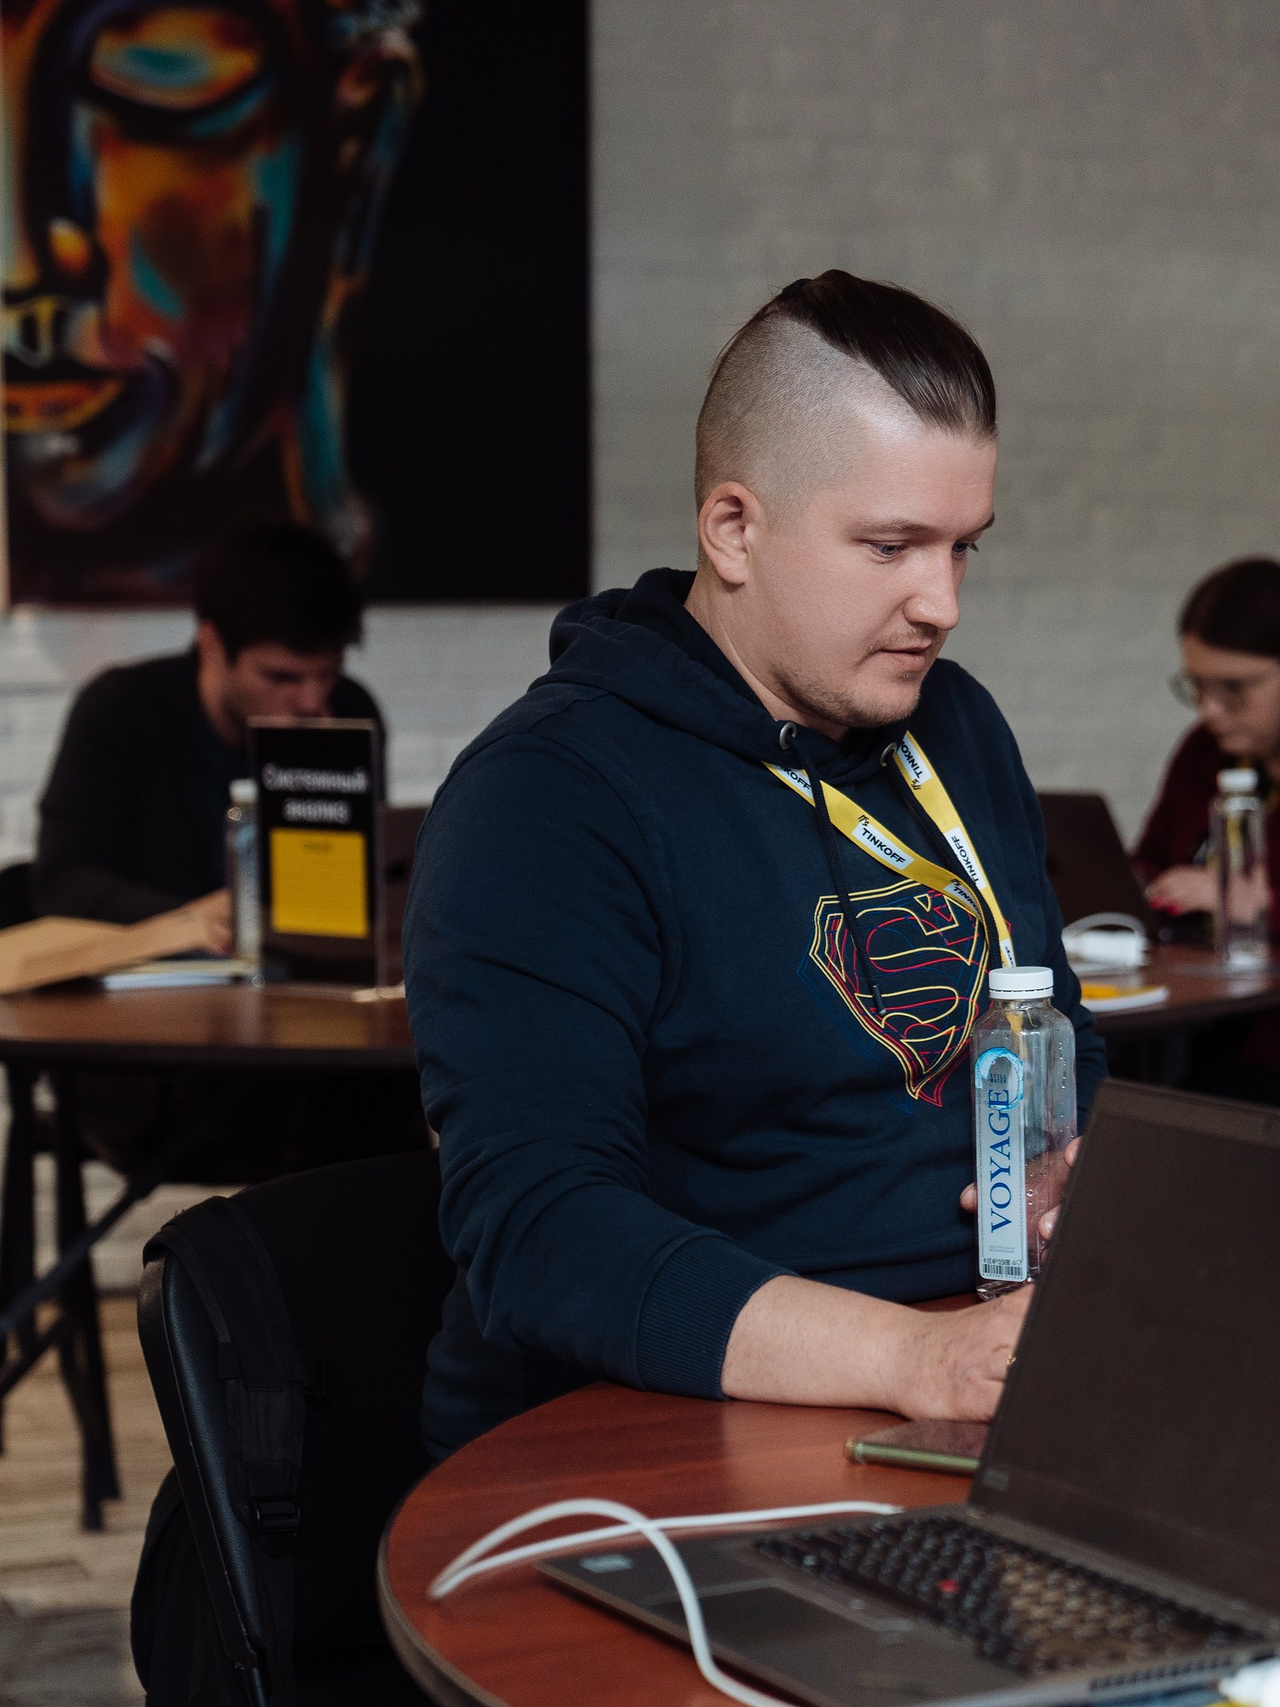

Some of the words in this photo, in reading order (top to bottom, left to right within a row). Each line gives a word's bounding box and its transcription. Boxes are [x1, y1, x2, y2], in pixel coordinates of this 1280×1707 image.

[901, 741, 922, 778] TINKO
[782, 767, 811, 790] KOFF
[862, 827, 906, 863] TINKOFF
[951, 835, 979, 883] TINKOFF
[988, 1089, 1012, 1233] VOYAGE
